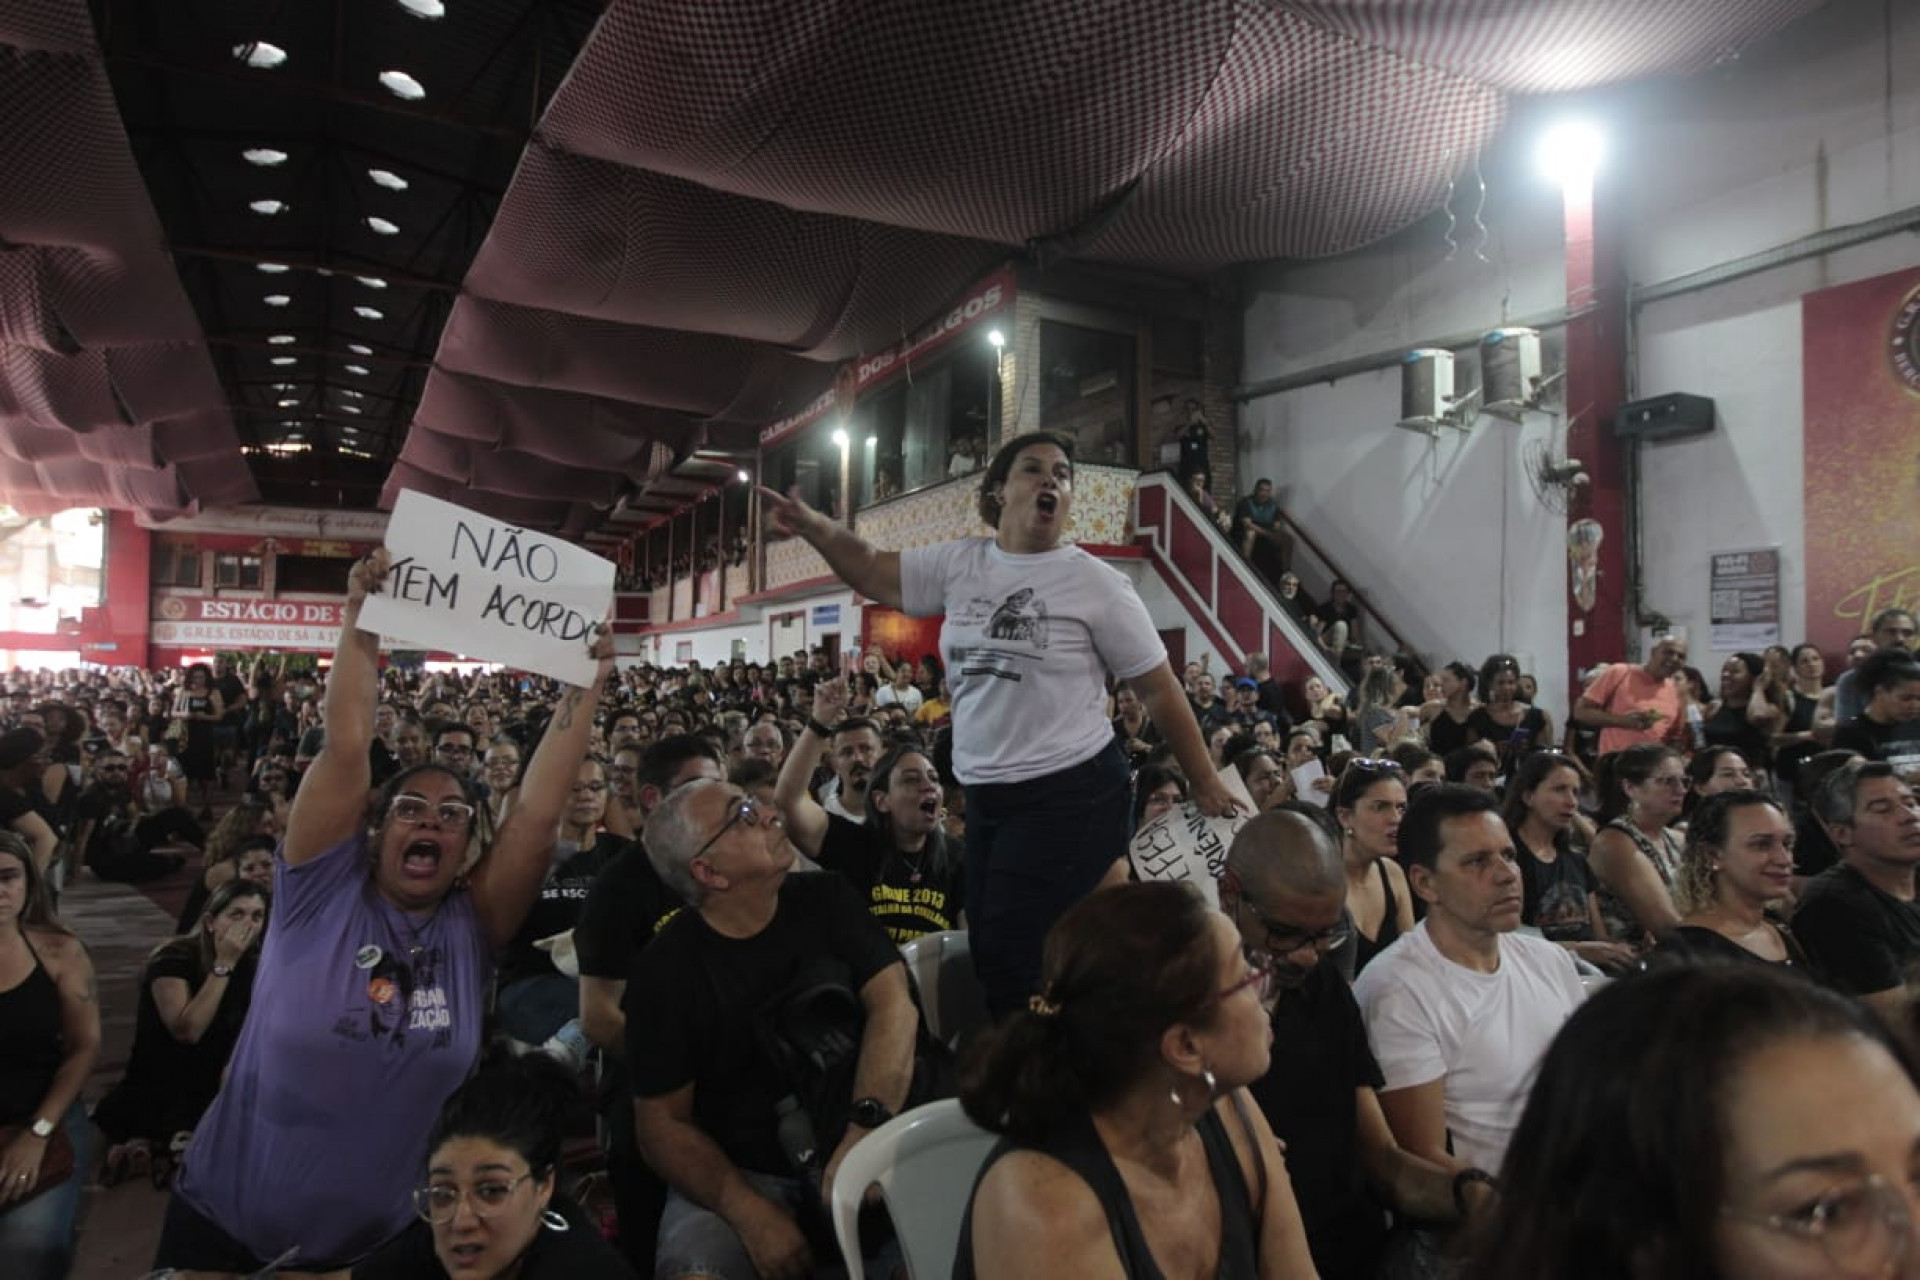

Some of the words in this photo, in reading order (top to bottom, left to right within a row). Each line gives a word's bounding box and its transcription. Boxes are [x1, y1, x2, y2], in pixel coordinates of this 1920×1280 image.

[452, 521, 558, 582] NÃO
[389, 556, 459, 610] TEM
[200, 600, 297, 621] ESTÁCIO
[303, 604, 334, 622] DE
[913, 888, 946, 909] 2013
